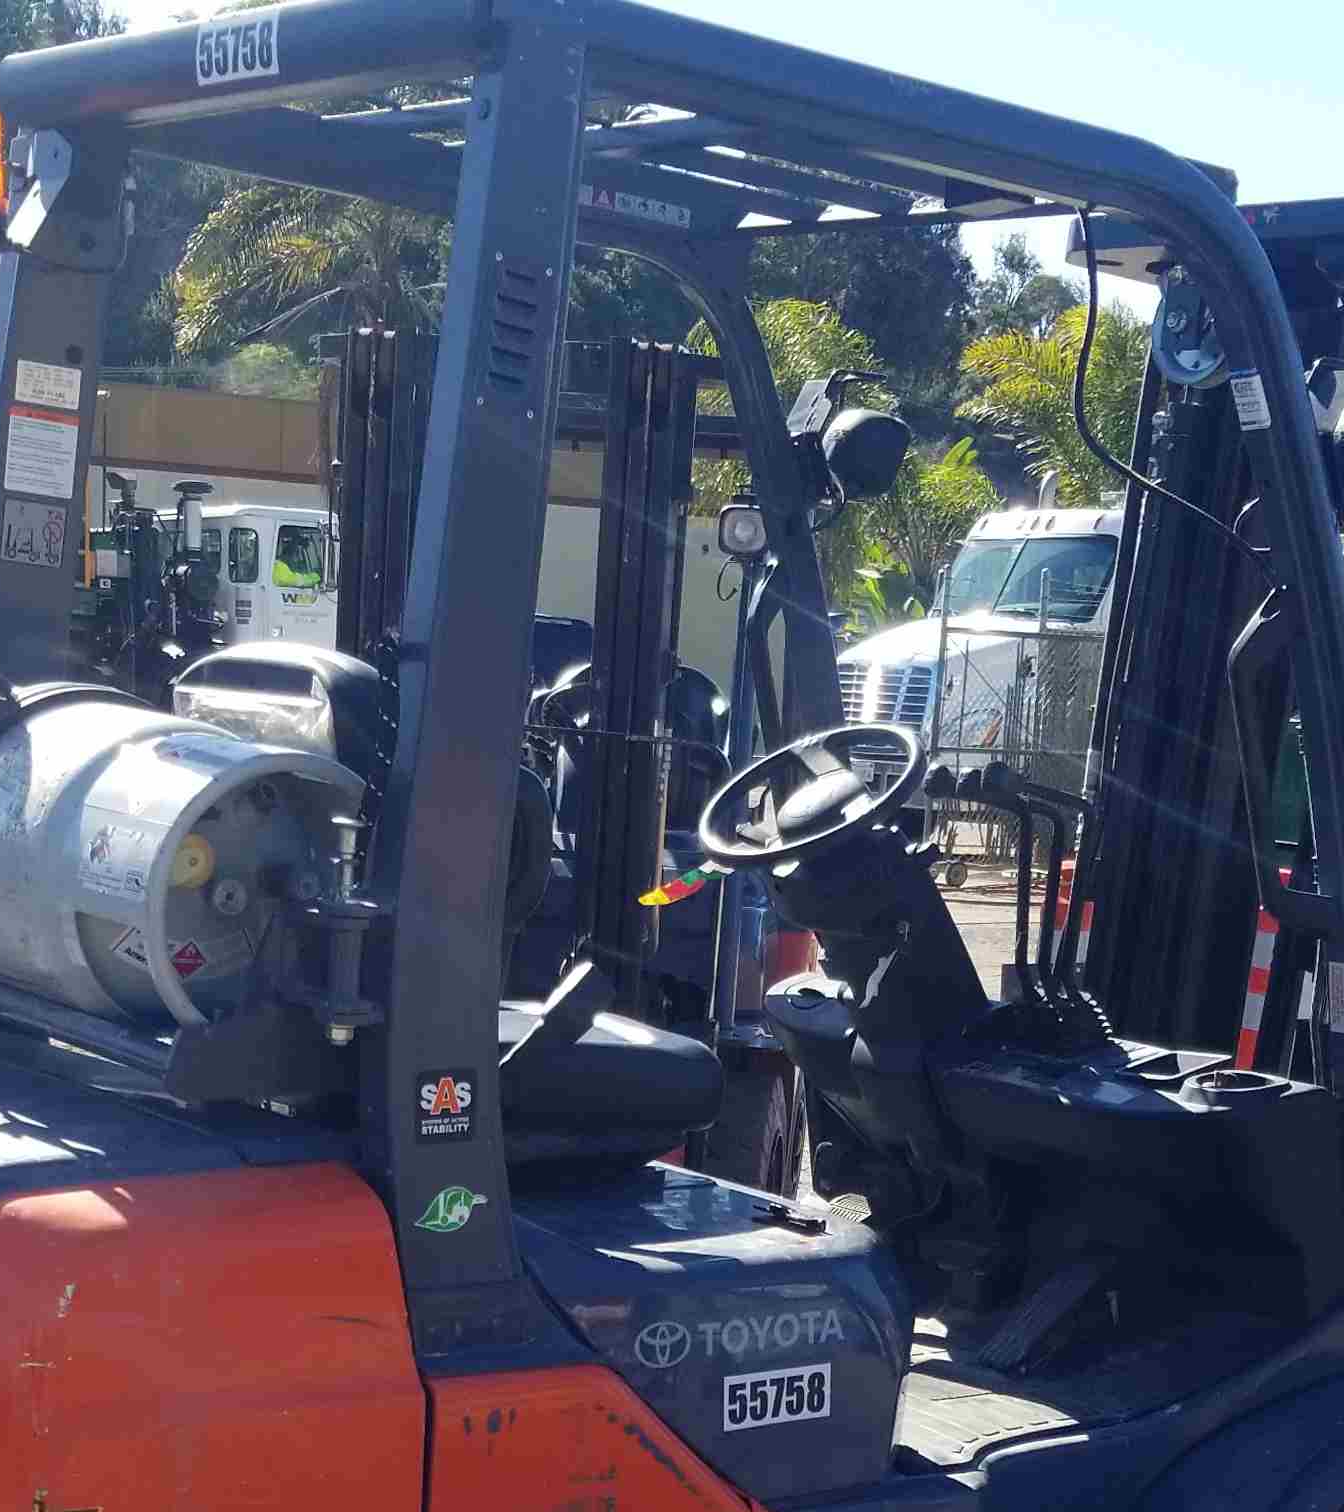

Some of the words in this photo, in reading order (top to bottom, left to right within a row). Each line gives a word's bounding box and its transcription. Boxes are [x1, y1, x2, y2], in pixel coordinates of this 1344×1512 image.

[199, 21, 273, 79] 55758
[420, 1077, 472, 1115] SAS
[421, 1123, 469, 1136] STABILITY
[698, 1309, 845, 1356] TOYOTA
[727, 1371, 826, 1425] 55758
